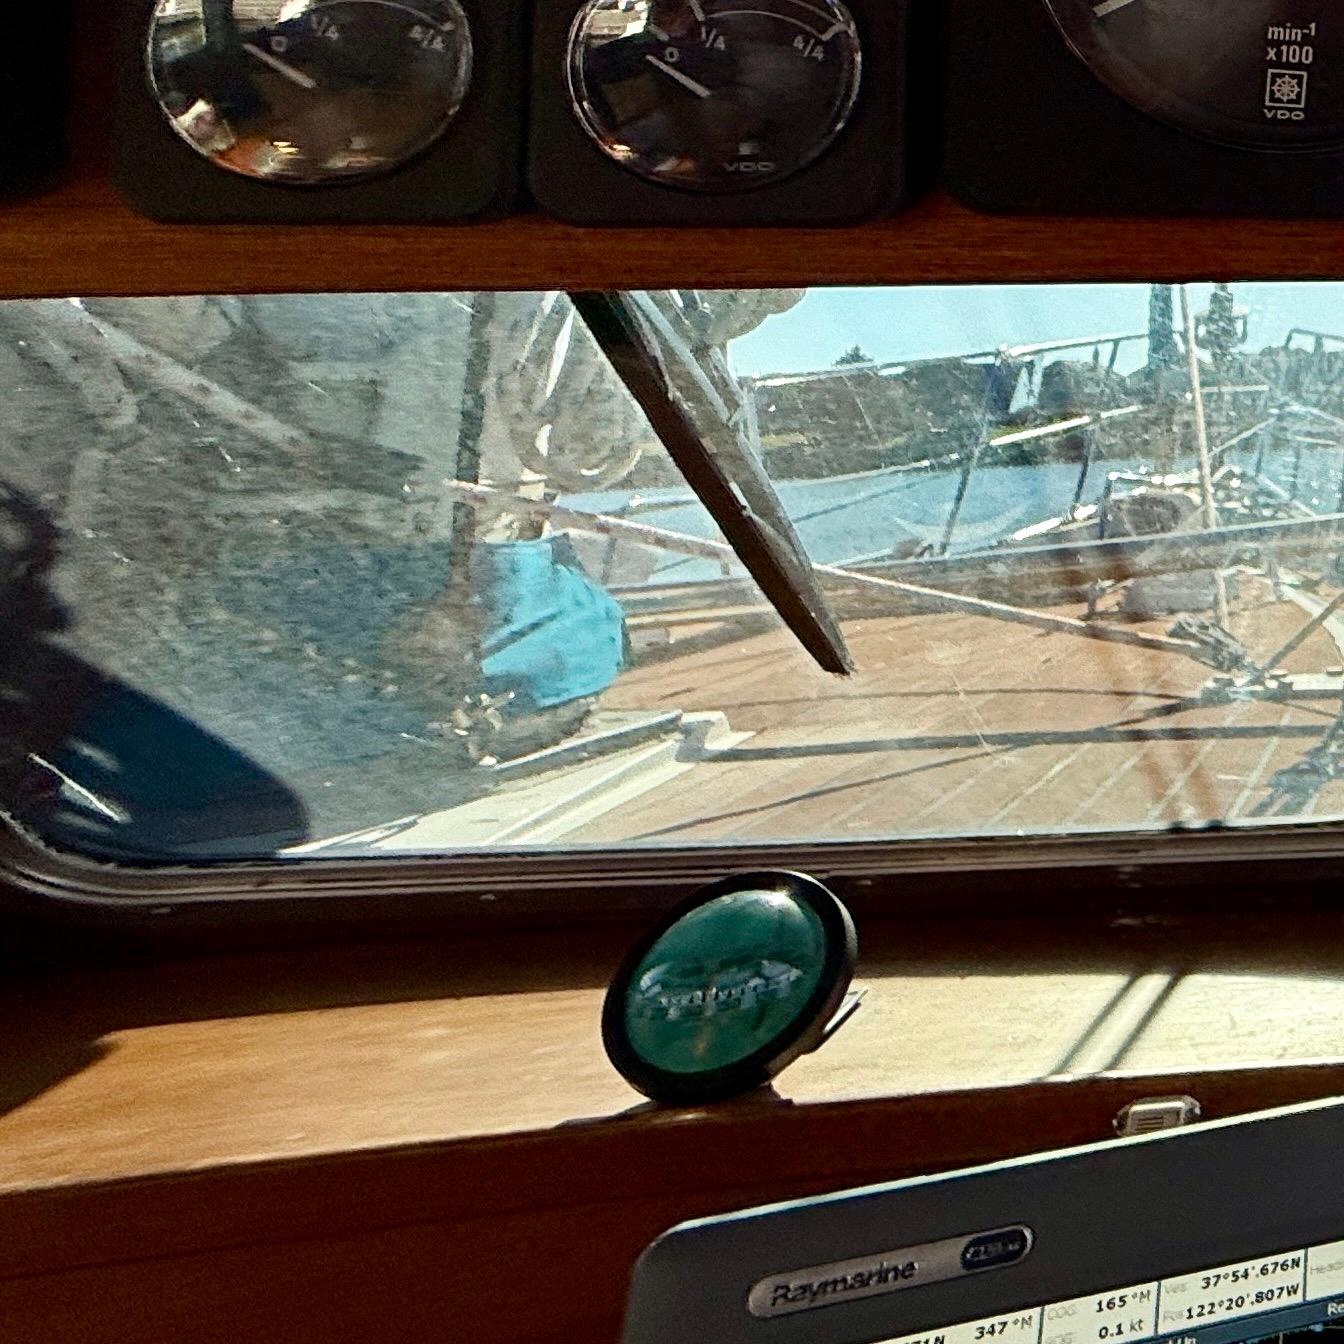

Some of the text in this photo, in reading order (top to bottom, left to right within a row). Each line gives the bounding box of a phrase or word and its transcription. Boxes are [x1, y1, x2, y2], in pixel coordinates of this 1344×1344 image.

[664, 47, 679, 63] 0
[1263, 109, 1305, 120] VDO
[722, 161, 776, 173] VDO
[771, 1261, 918, 1306] Raymarine
[1096, 1293, 1128, 1313] 165
[974, 1321, 1008, 1340] 347
[1098, 1318, 1145, 1339] 0.1 kt
